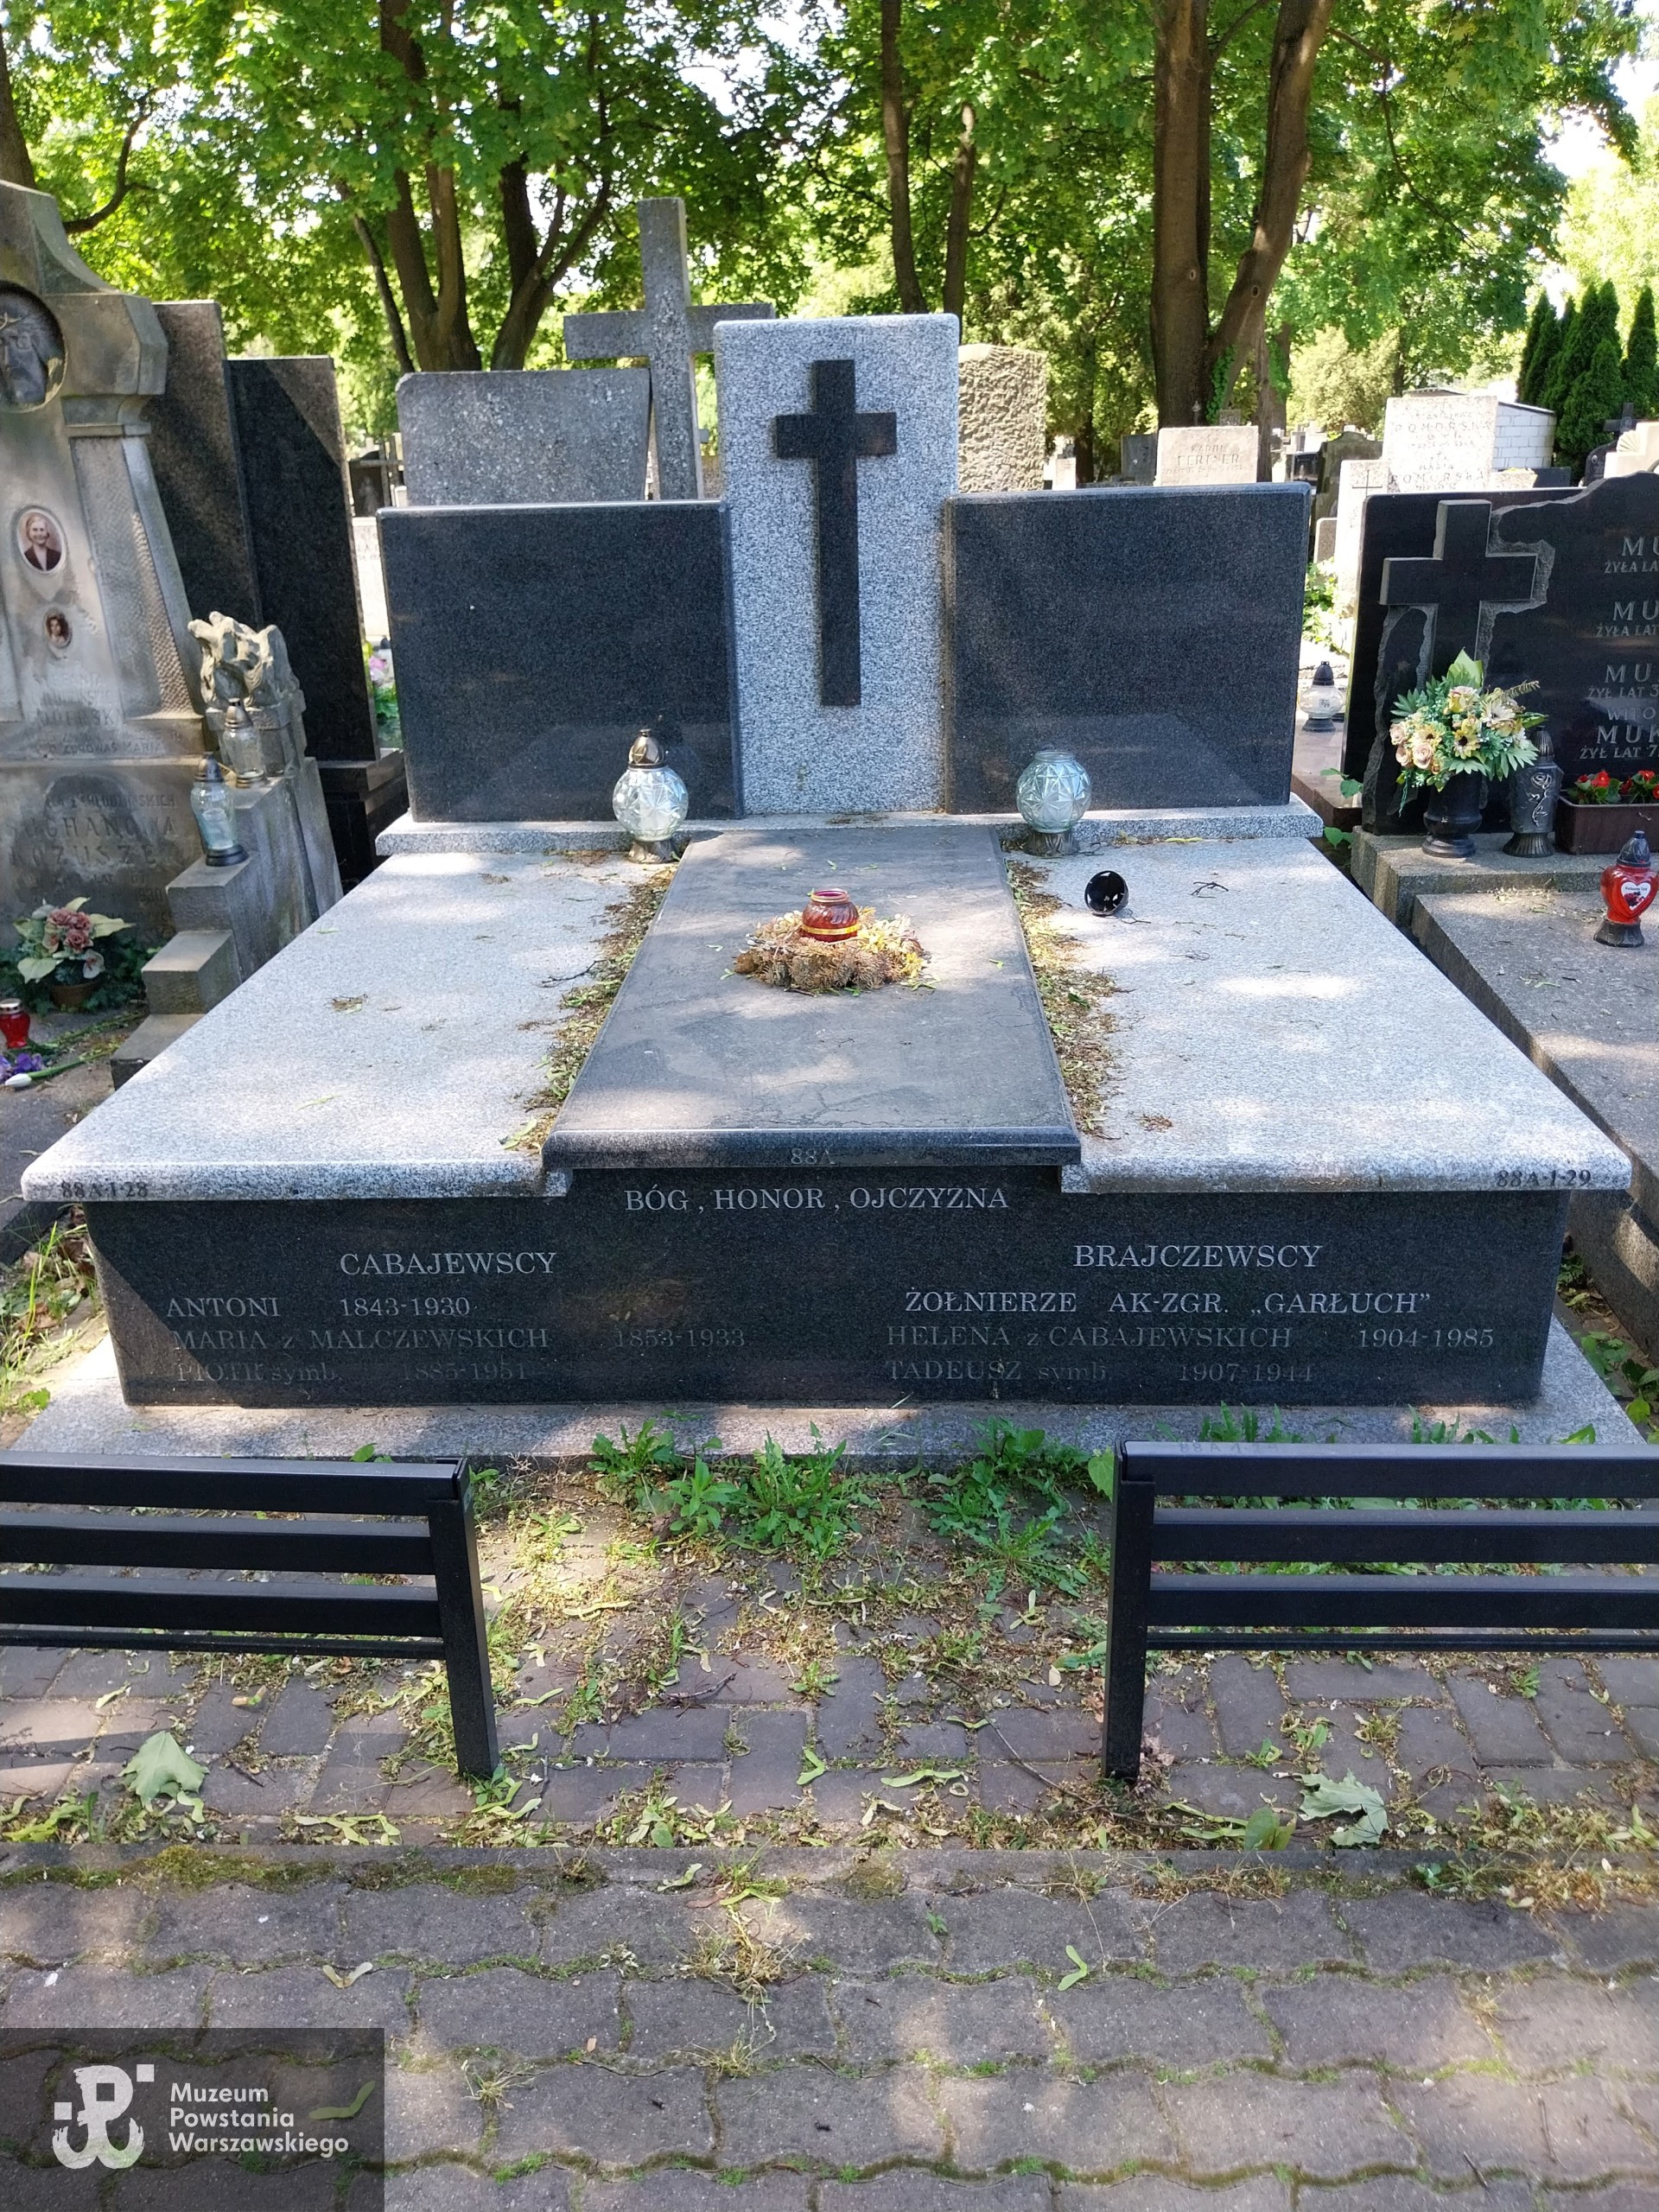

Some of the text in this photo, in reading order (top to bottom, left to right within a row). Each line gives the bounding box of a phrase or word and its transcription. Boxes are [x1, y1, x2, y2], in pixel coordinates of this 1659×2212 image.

[1618, 687, 1646, 699] LAT
[1580, 745, 1609, 760] ŻYŁ
[1613, 747, 1642, 759] LAT
[849, 1186, 1009, 1210] OJCZYZNA
[340, 1252, 557, 1275] CABAJEWSCY
[1073, 1244, 1323, 1268] BRAJCZEWSCY
[167, 1297, 470, 1317] ANTONI 1843-1930
[906, 1287, 1077, 1313] ŻOŁNIERZE
[171, 1330, 268, 1350] MARIA
[308, 1328, 550, 1350] MALCZEWSKICH
[887, 1326, 1011, 1345] HELENA
[1049, 1326, 1294, 1347] CABAJEWSKICH
[1358, 1328, 1494, 1348] 1904-1985
[885, 1360, 1022, 1380] TADEUSZ
